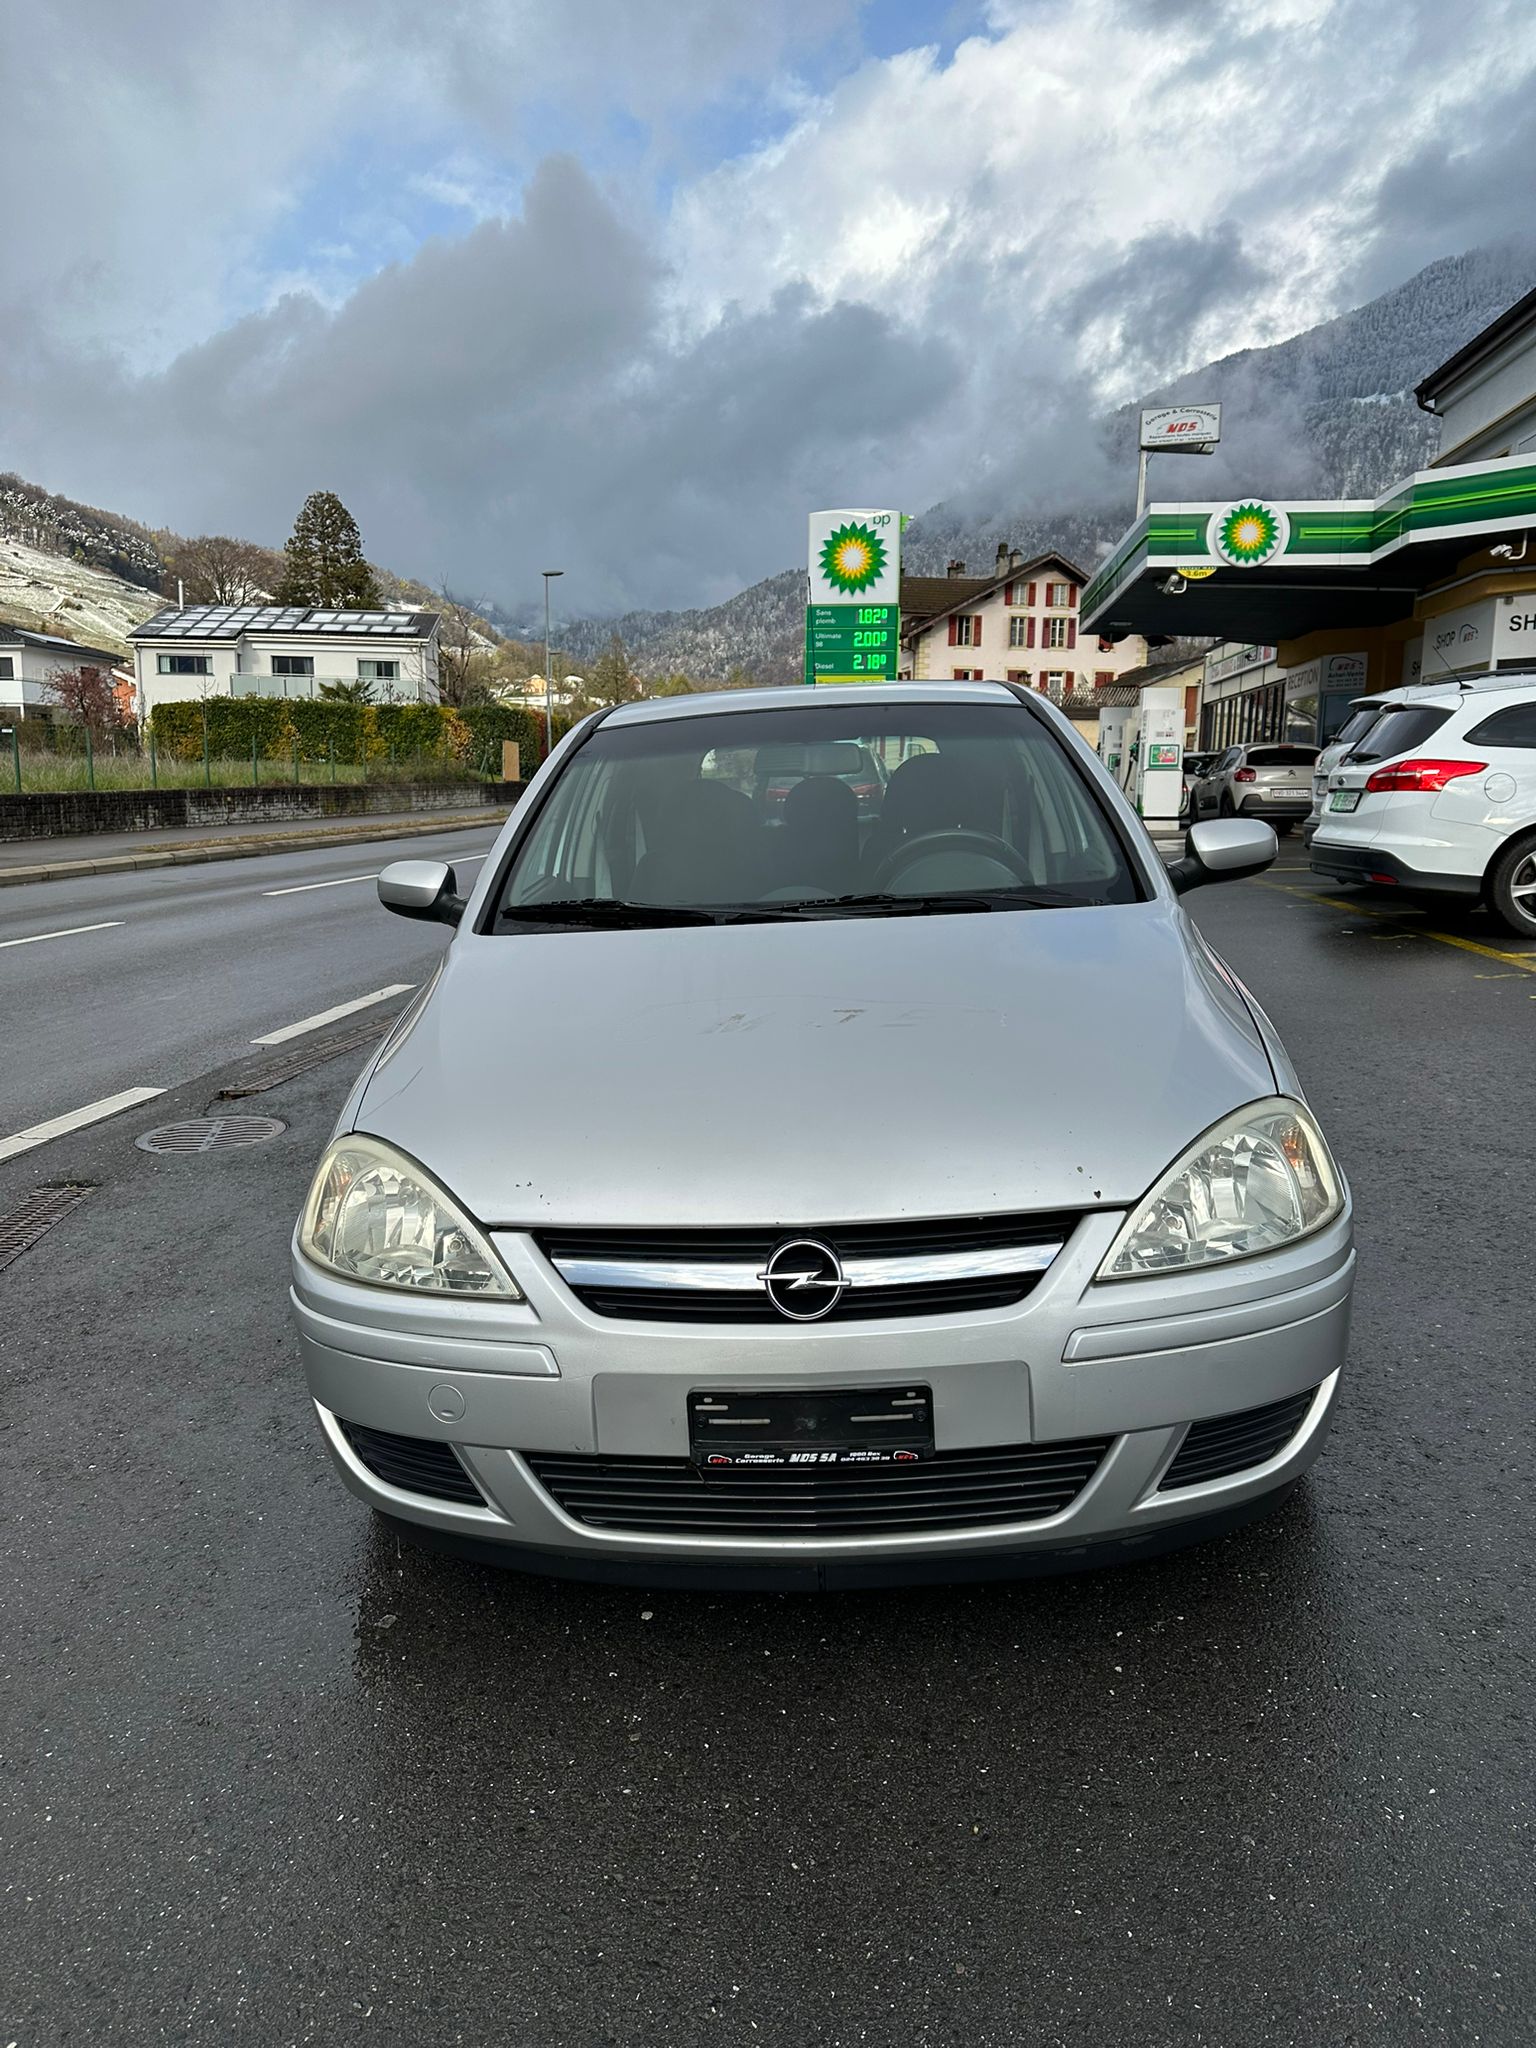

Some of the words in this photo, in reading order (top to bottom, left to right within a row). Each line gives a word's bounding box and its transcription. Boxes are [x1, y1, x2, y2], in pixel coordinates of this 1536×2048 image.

[1145, 411, 1171, 426] Garage
[1180, 407, 1218, 421] Carrosserie
[1436, 630, 1456, 650] SHOP
[818, 1453, 837, 1463] SA
